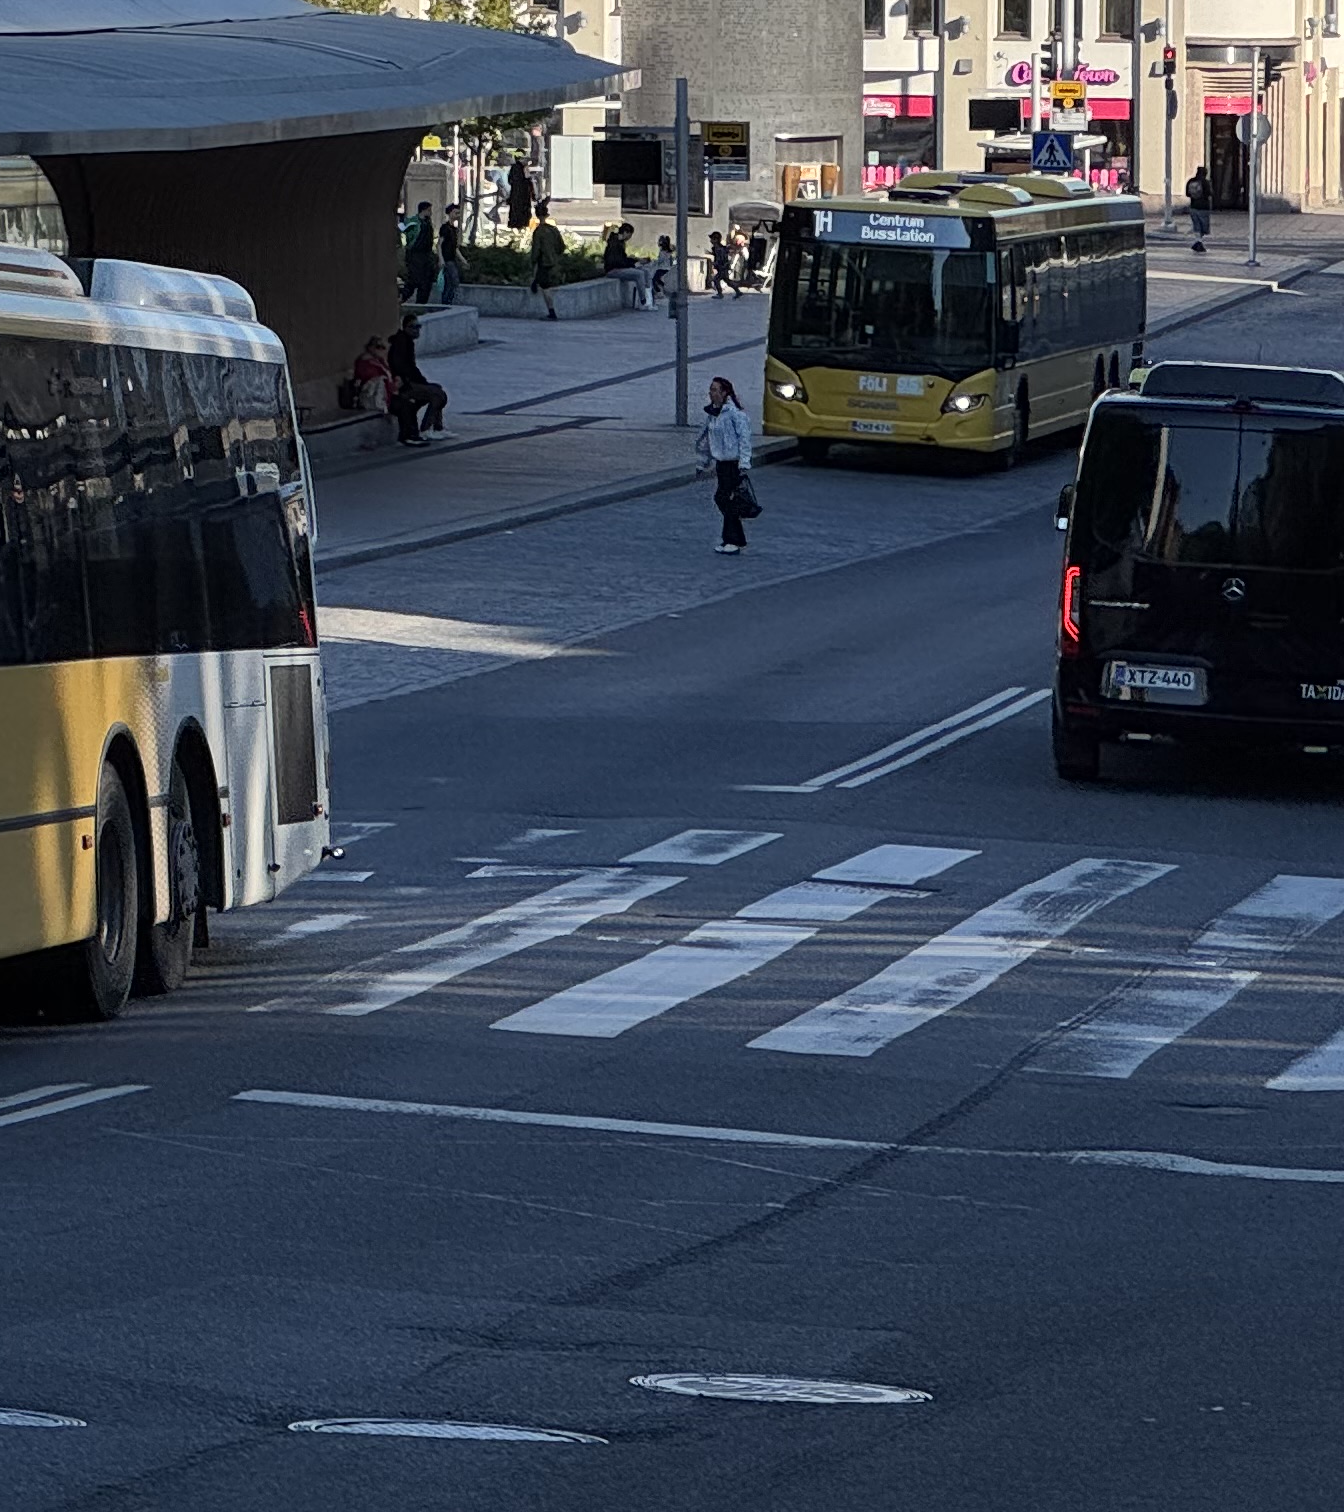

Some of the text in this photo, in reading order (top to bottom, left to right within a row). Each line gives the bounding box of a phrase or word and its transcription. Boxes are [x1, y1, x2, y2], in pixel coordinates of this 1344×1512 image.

[869, 213, 925, 228] Centrum
[859, 375, 888, 392] FÖLI
[1128, 668, 1191, 687] XTZ-440
[1300, 683, 1344, 701] TAXID
